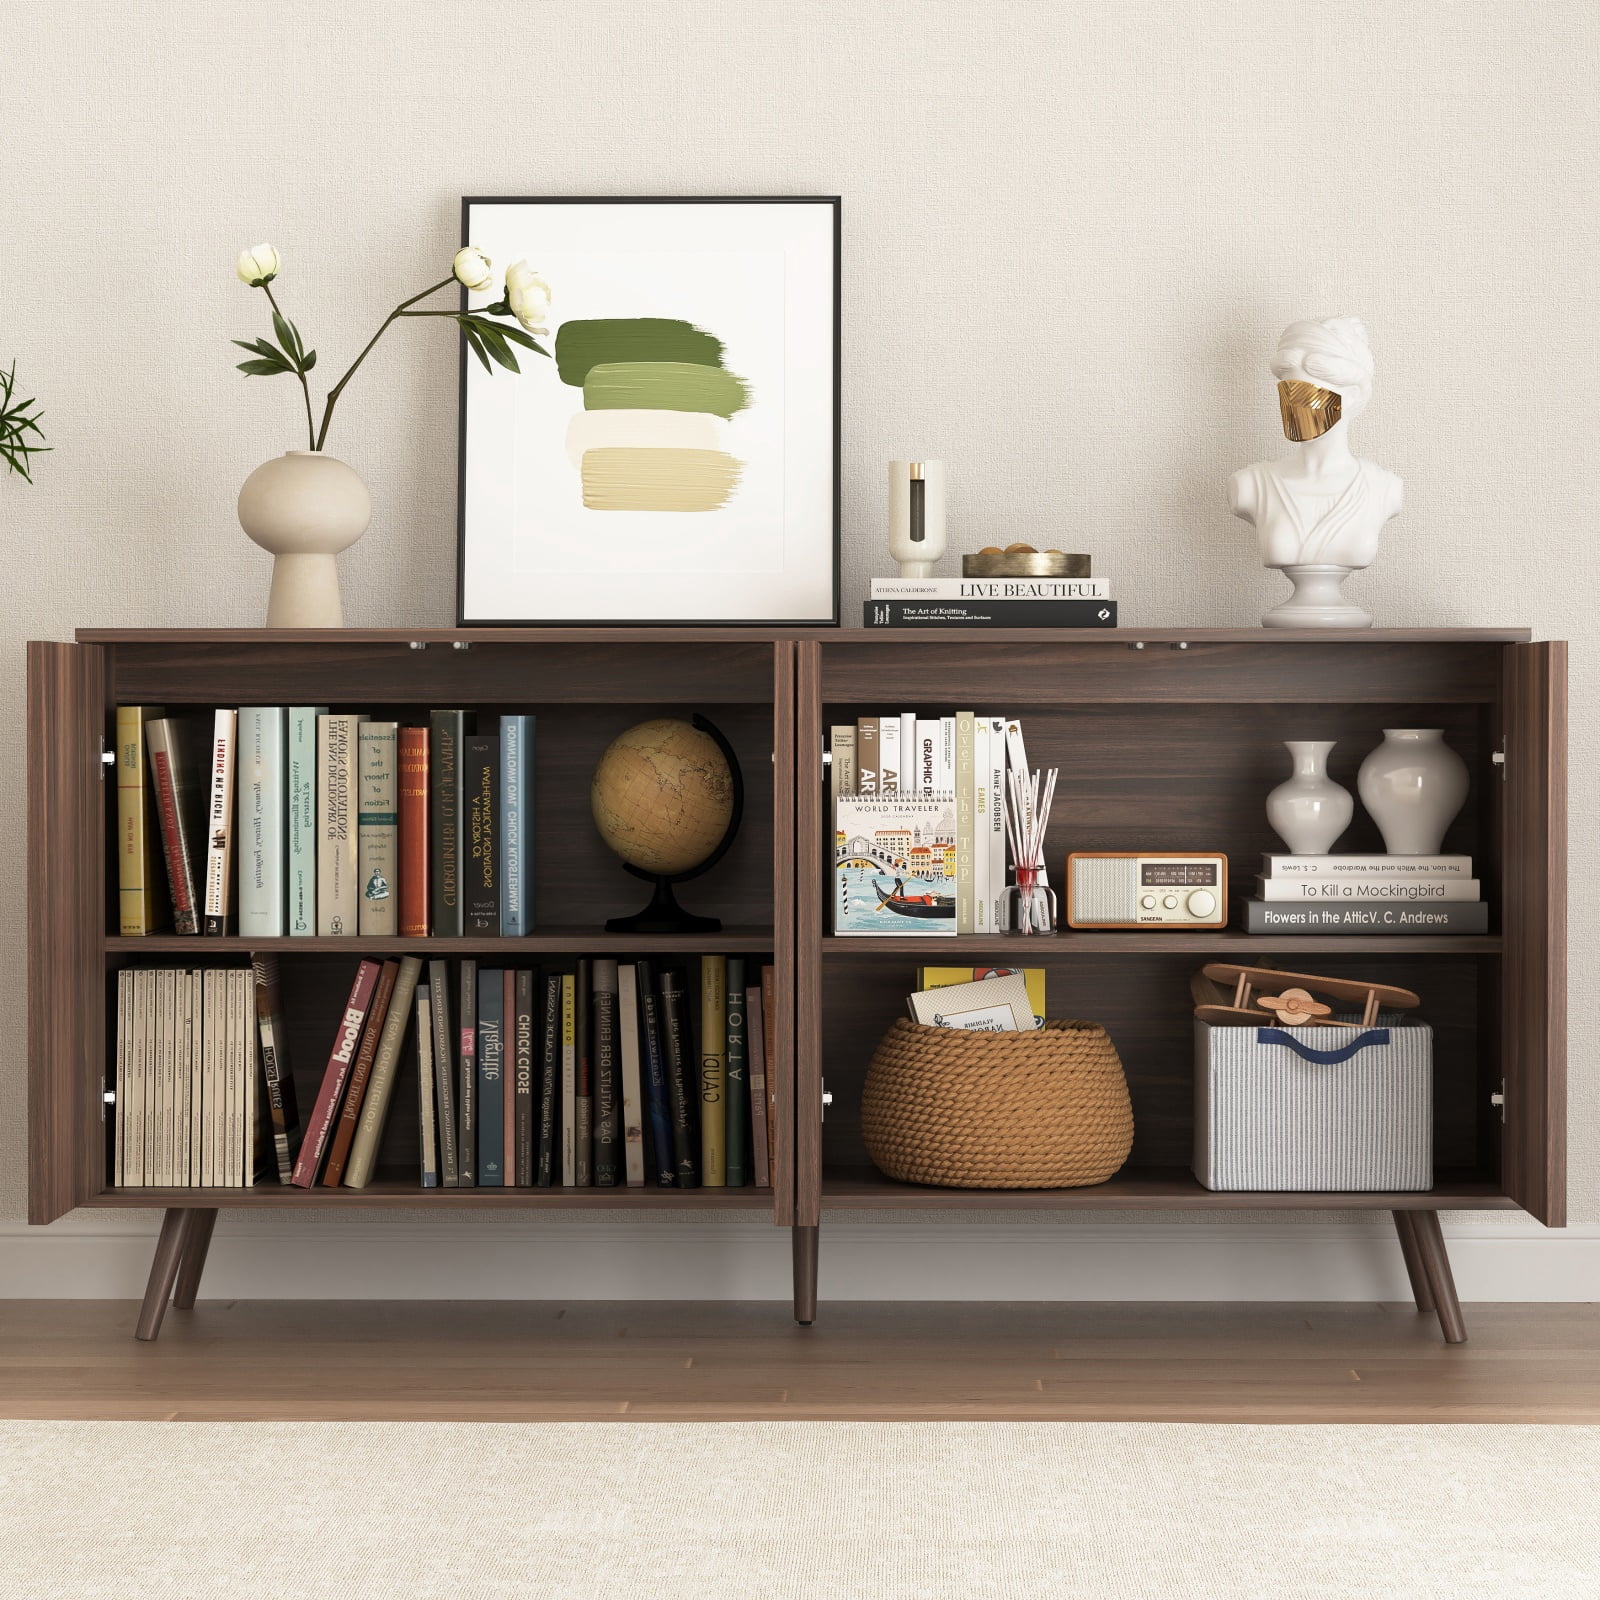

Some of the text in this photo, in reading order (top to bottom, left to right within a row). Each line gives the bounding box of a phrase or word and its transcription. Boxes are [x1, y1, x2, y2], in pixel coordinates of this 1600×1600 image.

[960, 584, 1102, 597] LIVE BEAUTIFUL
[939, 608, 967, 617] Knitting
[924, 739, 932, 784] GRAPHIC
[1301, 884, 1445, 899] To Kill a Mockingbird
[1264, 911, 1306, 924] Flowers
[1309, 911, 1319, 924] in
[1322, 911, 1340, 924] the
[1384, 911, 1396, 924] C.
[1400, 911, 1448, 924] Andrews
